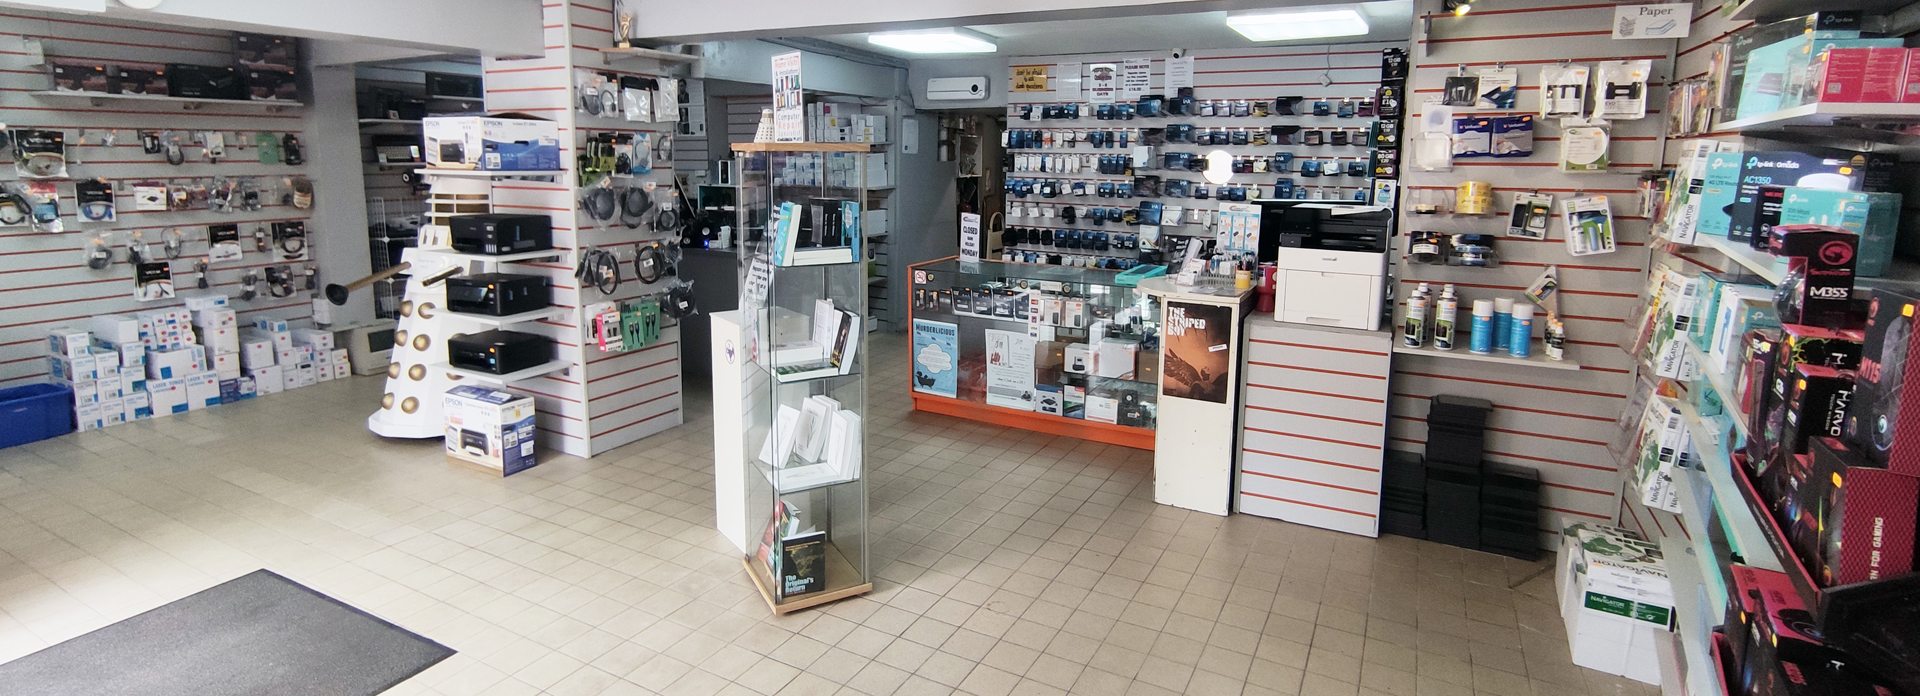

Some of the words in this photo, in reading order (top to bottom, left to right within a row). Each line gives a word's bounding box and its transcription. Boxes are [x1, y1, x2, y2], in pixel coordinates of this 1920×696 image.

[1639, 6, 1673, 17] Paper
[778, 122, 800, 130] Repair
[1743, 176, 1771, 184] AC1350
[1679, 204, 1694, 238] NAVIGATOR
[963, 226, 978, 235] CLOSED
[962, 248, 978, 257] MONDAY
[1810, 286, 1849, 298] M355
[1168, 307, 1185, 318] THE
[1168, 317, 1206, 330] STRIPED
[916, 324, 955, 336] MURDERLICIOUS
[1168, 326, 1186, 337] BOY
[1664, 340, 1680, 372] NAVIGATOR
[445, 397, 462, 406] EPSON
[1830, 390, 1851, 436] MARVO
[1650, 472, 1664, 502] NAVIGATOR
[1873, 517, 1883, 548] GAMING
[1870, 550, 1881, 567] FOR
[1593, 560, 1668, 578] NAVIGATOR
[785, 577, 814, 587] Original's
[786, 585, 806, 593] Return
[1590, 596, 1624, 607] NAVIGATOR
